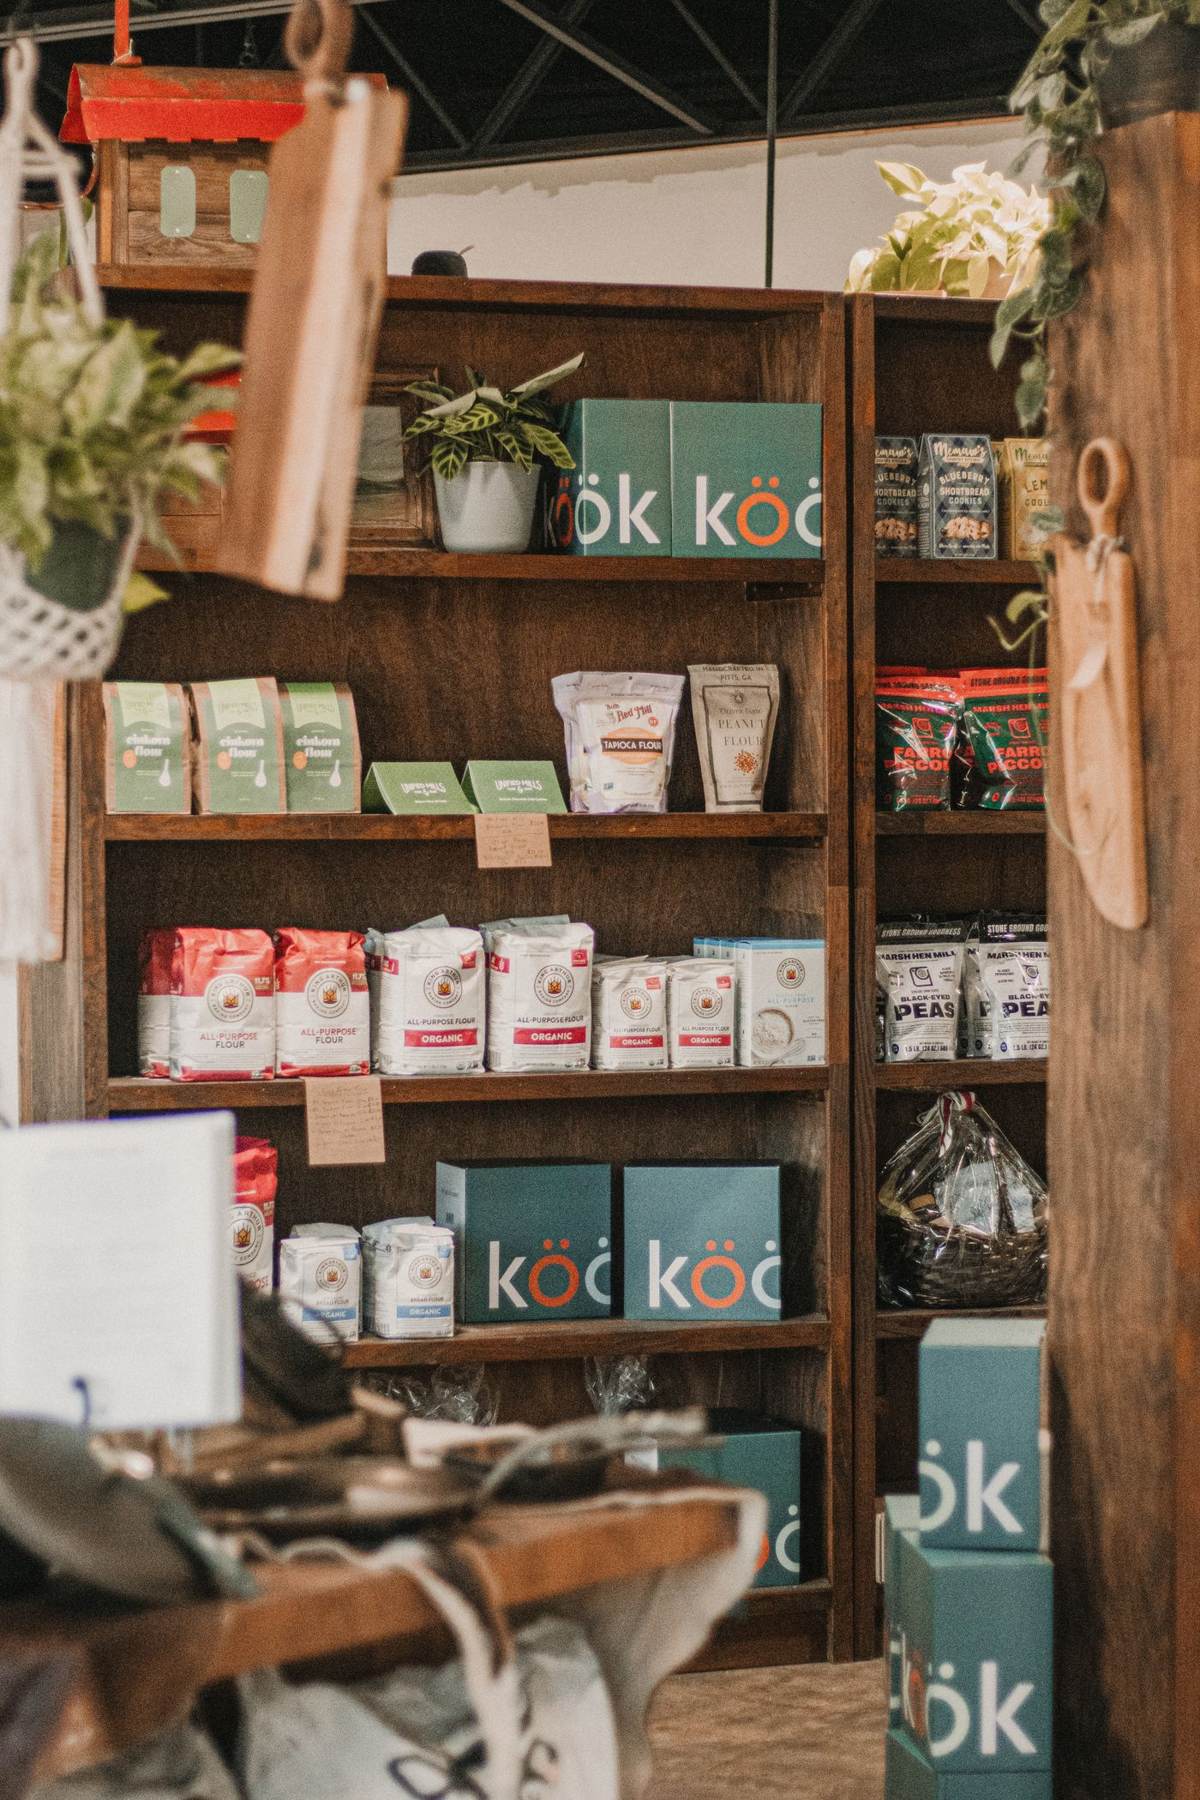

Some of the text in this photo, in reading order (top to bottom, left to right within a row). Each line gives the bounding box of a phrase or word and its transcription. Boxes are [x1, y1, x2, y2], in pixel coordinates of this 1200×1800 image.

[939, 472, 990, 486] BLUEBERRY
[940, 487, 990, 496] SHORTBREAD
[949, 497, 982, 505] COOKIES
[604, 741, 661, 750] TAPIOCA FLOUR
[988, 924, 1008, 934] STONE
[1009, 924, 1035, 932] GROUND
[912, 951, 932, 960] HEN
[933, 950, 957, 958] MILL
[901, 994, 951, 1002] BLACK-EYED
[894, 1002, 955, 1021] PEAS
[200, 1031, 257, 1041] ALL-PURPOSE
[301, 1027, 357, 1036] ALL-PURPOSE
[315, 1036, 344, 1044] FLOUR
[422, 1033, 463, 1043] ORGANIC
[531, 1032, 573, 1041] ORGANIC
[215, 1040, 246, 1049] FLOUR
[622, 1038, 653, 1046] ORGANIC
[316, 1311, 347, 1319] RGANIC
[409, 1308, 441, 1316] ORGANIC
